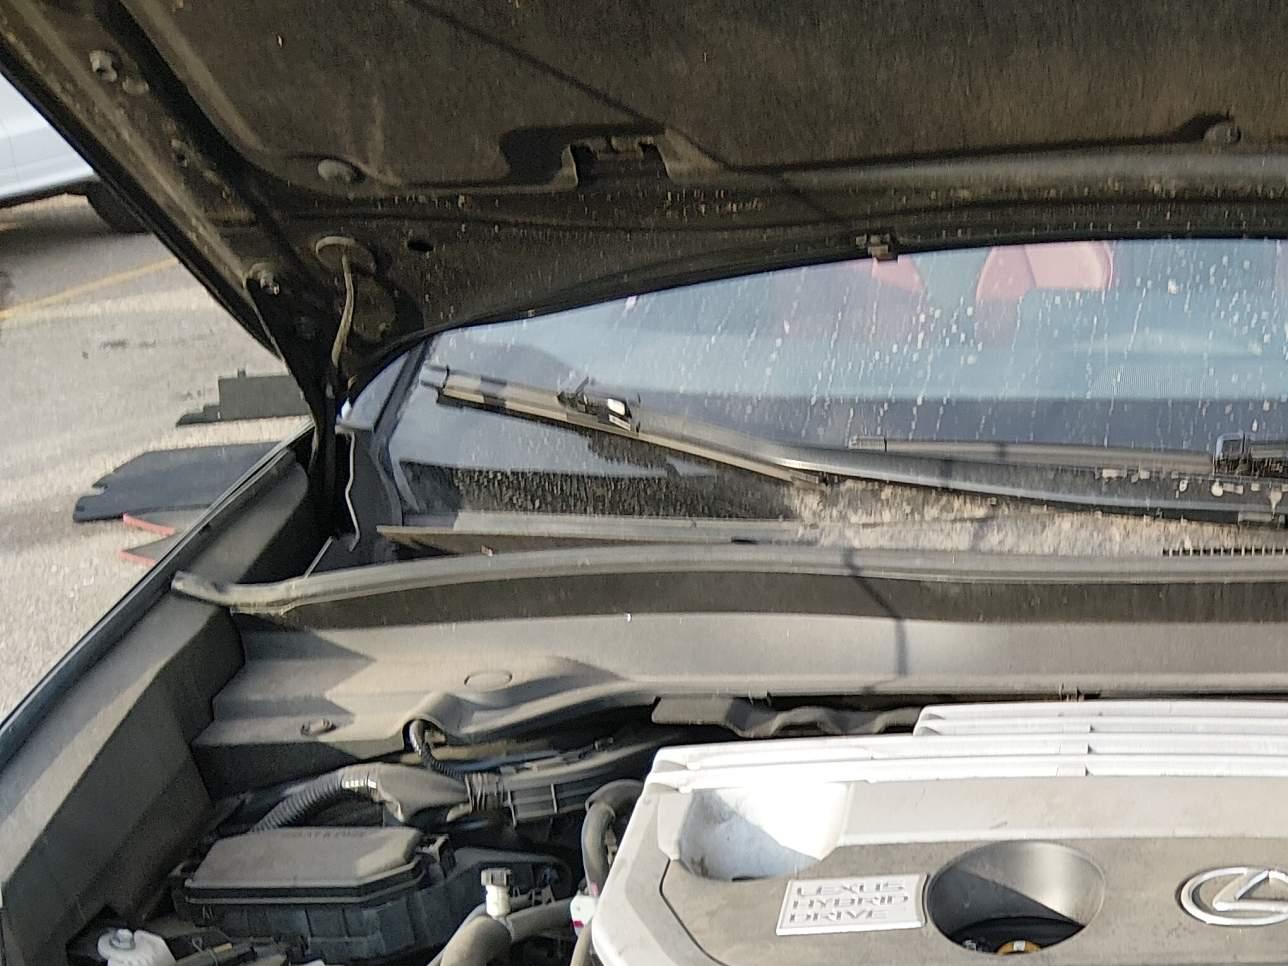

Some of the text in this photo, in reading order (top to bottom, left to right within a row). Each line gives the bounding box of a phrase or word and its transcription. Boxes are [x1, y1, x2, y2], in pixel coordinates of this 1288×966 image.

[796, 881, 905, 897] LEXUS
[792, 894, 909, 909] HYBRID
[788, 908, 888, 923] DRIVE
